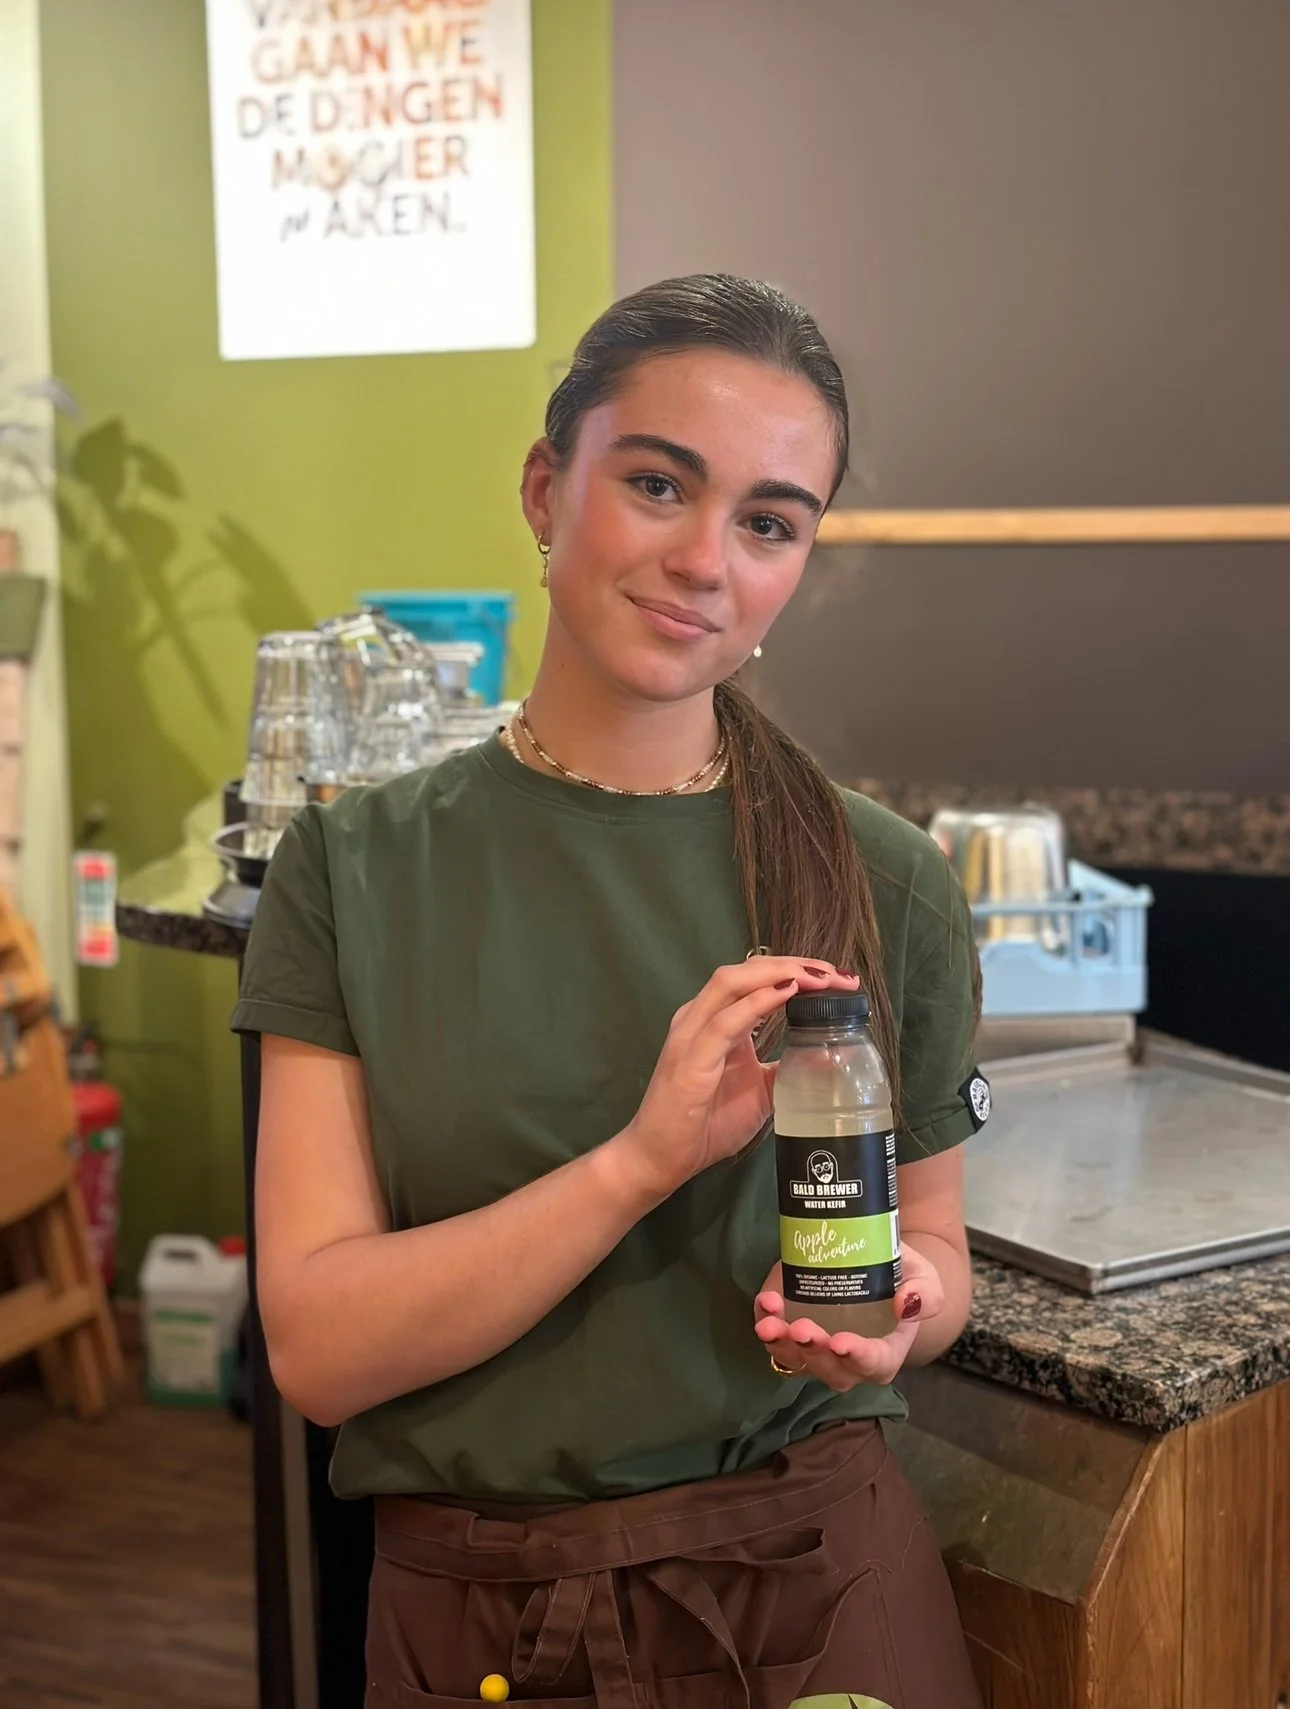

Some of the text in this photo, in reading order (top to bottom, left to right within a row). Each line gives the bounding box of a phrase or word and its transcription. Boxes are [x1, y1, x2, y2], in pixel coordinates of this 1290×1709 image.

[250, 18, 484, 84] GAAN WE
[237, 92, 297, 140] DE
[793, 1183, 859, 1196] BALD BREWER
[804, 1200, 847, 1209] WATER KEFIR
[808, 1237, 867, 1263] adventure
